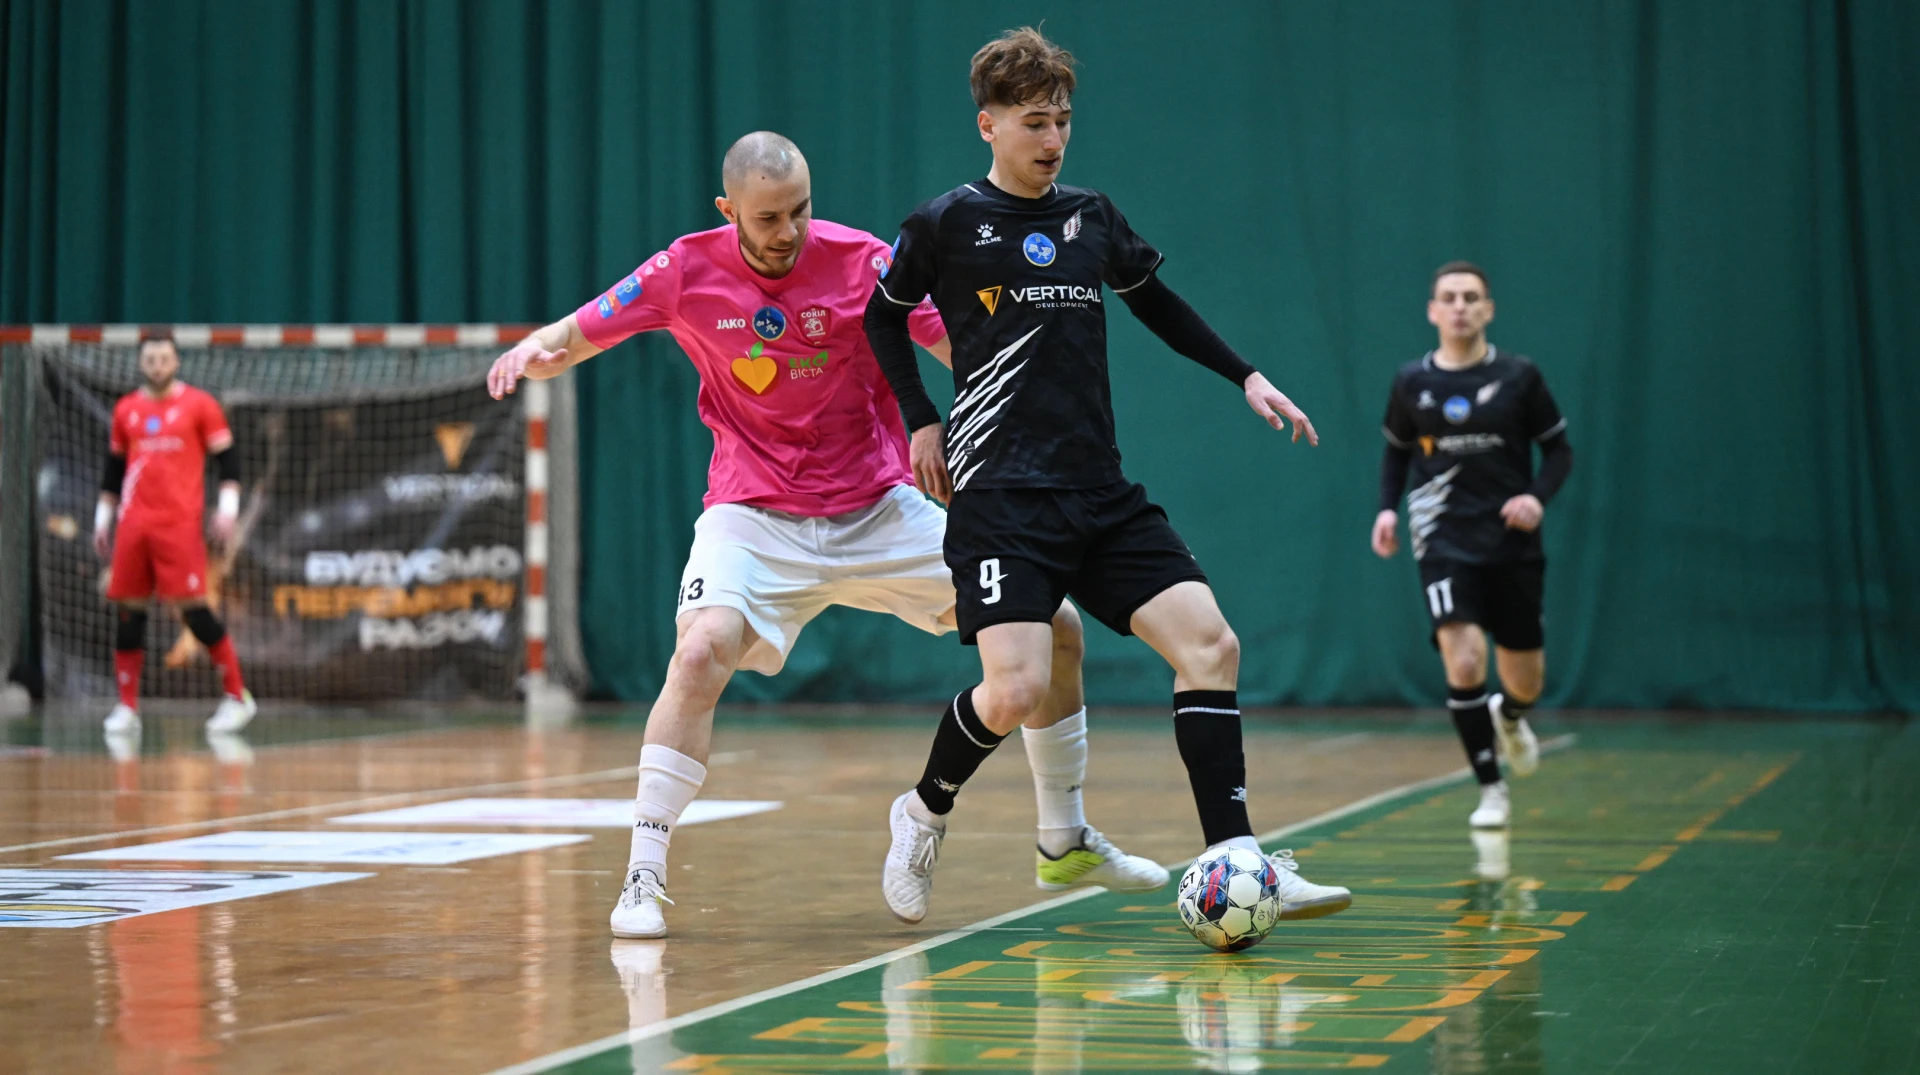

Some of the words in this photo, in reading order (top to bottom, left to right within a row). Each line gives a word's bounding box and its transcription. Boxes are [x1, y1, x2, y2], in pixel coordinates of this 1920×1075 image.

[975, 236, 1002, 246] KELME
[1009, 285, 1101, 303] VERTICAL
[1035, 301, 1088, 309] DEVELOPMENT
[801, 310, 826, 318] СОКІЛ
[716, 318, 746, 330] JAKO
[979, 557, 1009, 605] 9
[1427, 577, 1455, 618] 11
[635, 820, 669, 833] JAKO
